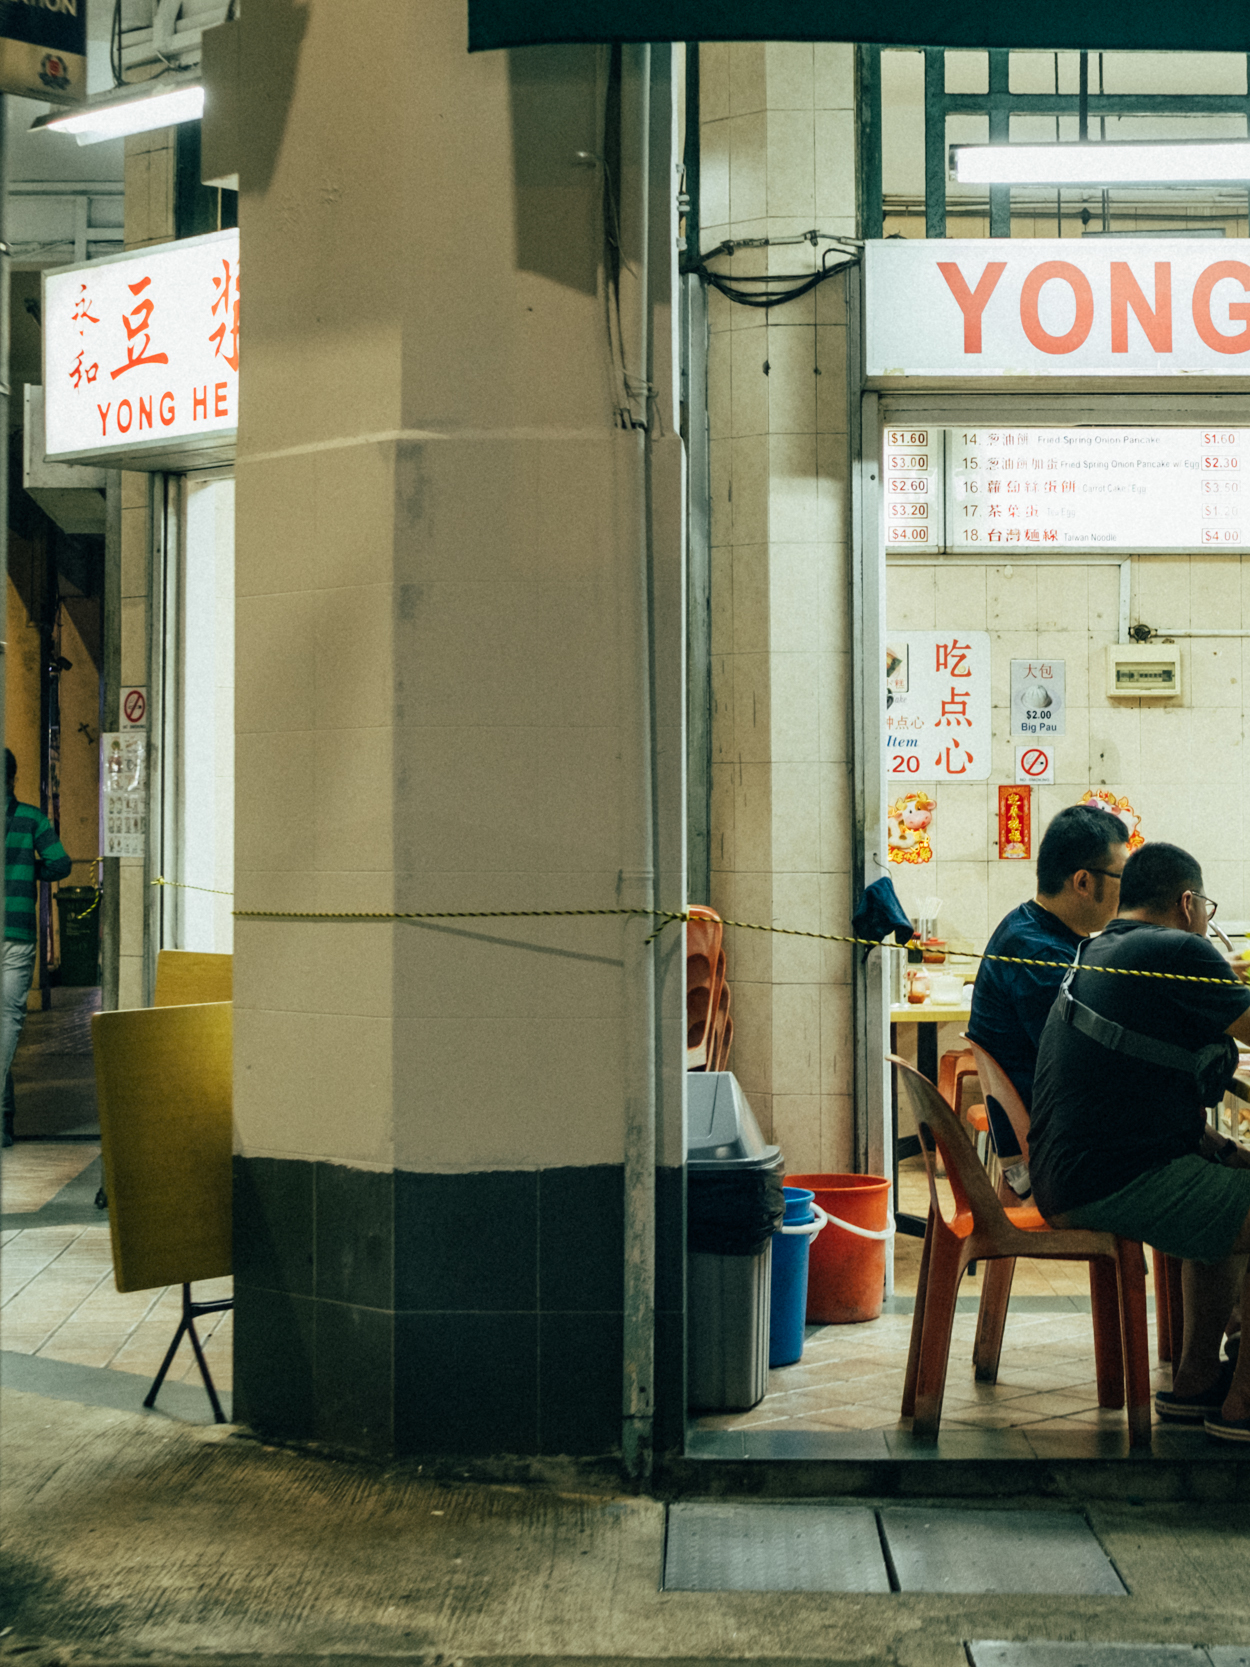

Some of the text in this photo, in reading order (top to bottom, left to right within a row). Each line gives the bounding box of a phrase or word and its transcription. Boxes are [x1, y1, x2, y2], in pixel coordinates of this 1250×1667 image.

[97, 381, 229, 436] YONG HE
[891, 433, 925, 446] $1.60
[1037, 435, 1061, 445] Fried
[1063, 435, 1092, 447] Spring
[1094, 435, 1120, 445] Onion
[1123, 435, 1160, 445] Pancake
[1204, 433, 1236, 445] $1.60
[891, 457, 926, 469] $3.00
[1082, 460, 1109, 471] Spring
[1111, 460, 1134, 469] Onion
[1136, 460, 1169, 469] Pancake
[1184, 460, 1200, 471] Egg
[1204, 457, 1238, 469] $2.30
[891, 480, 926, 493] $2.60
[1204, 481, 1239, 493] $3.50
[891, 504, 926, 517] $3.20
[891, 528, 926, 541] $4.00
[1204, 530, 1239, 542] $4.00
[1022, 663, 1053, 680] 大包
[934, 639, 973, 774] 吃点心
[1026, 710, 1051, 720] $2.00
[1021, 722, 1057, 733] Big Pau
